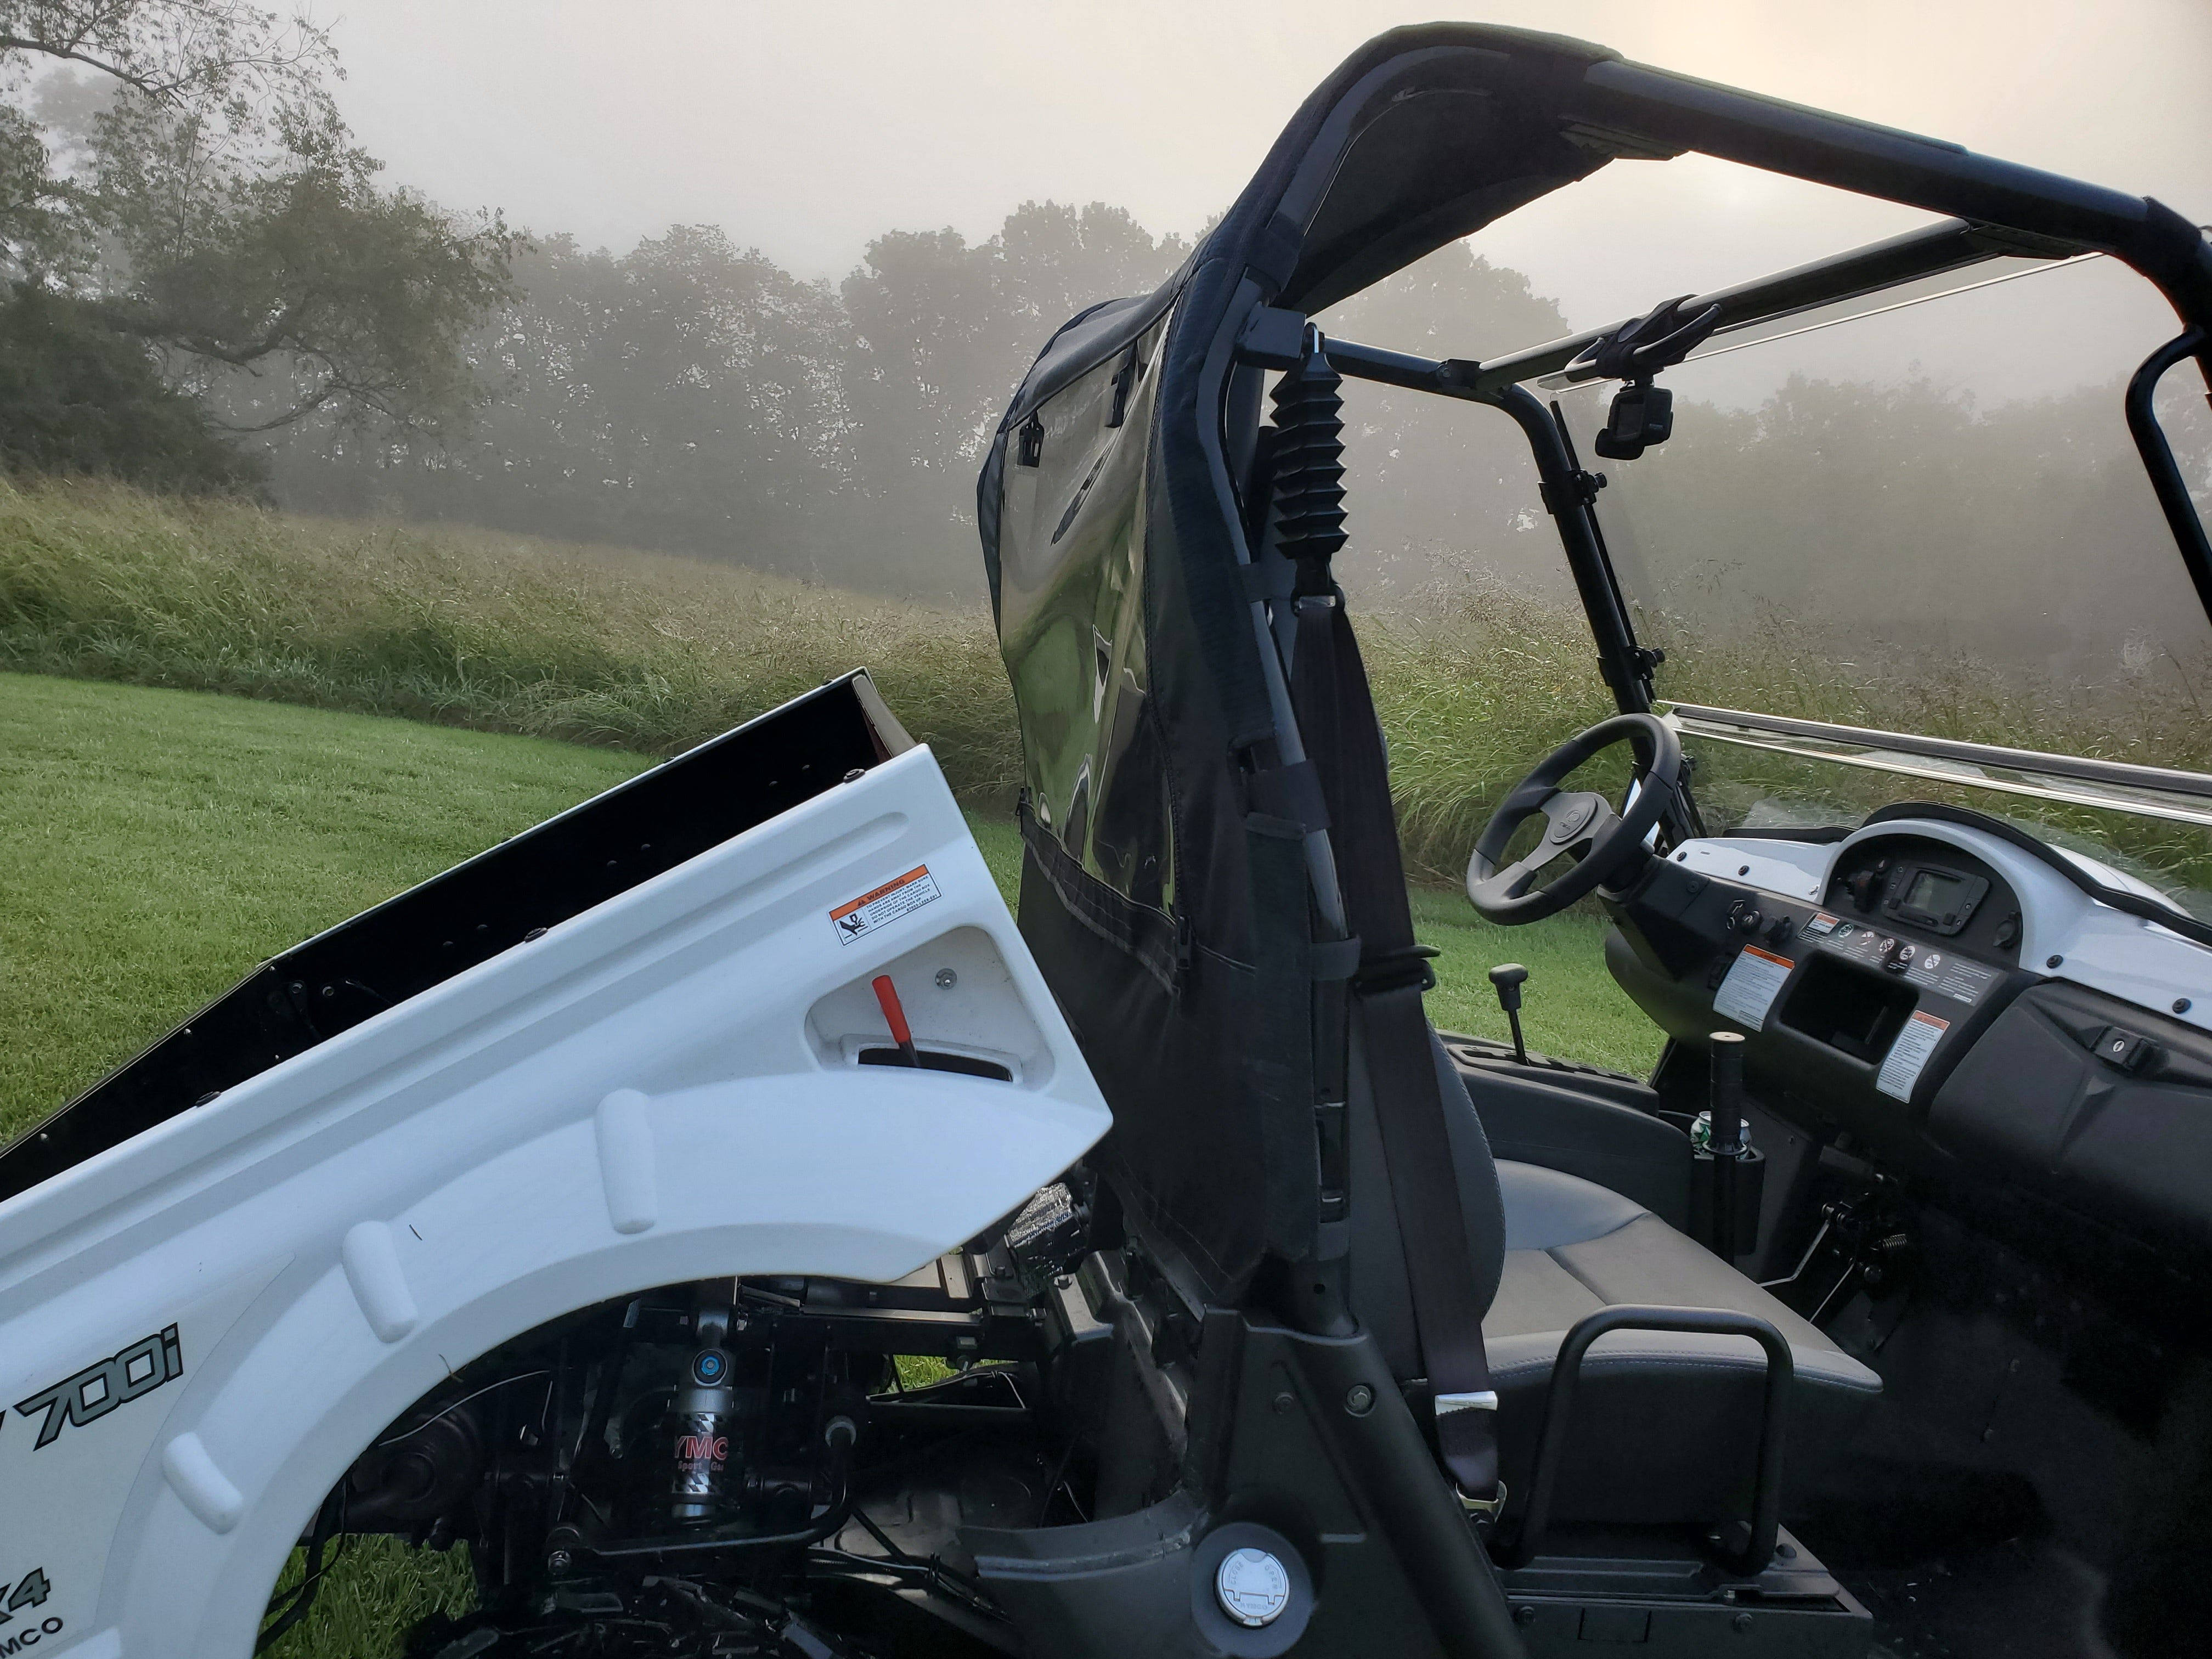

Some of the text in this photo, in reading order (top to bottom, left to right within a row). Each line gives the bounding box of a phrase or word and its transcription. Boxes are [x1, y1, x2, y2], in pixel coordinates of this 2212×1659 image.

[867, 878, 905, 900] WARNING
[907, 888, 921, 896] CARGO
[872, 895, 890, 905] PREVENT
[887, 901, 905, 912] OPERATE
[913, 888, 930, 898] VEHICLE
[868, 904, 882, 912] HANDS
[892, 905, 906, 913] CARGO
[13, 1322, 183, 1452] 700i
[678, 1460, 703, 1472] Sport
[1265, 1565, 1278, 1589] OPEN
